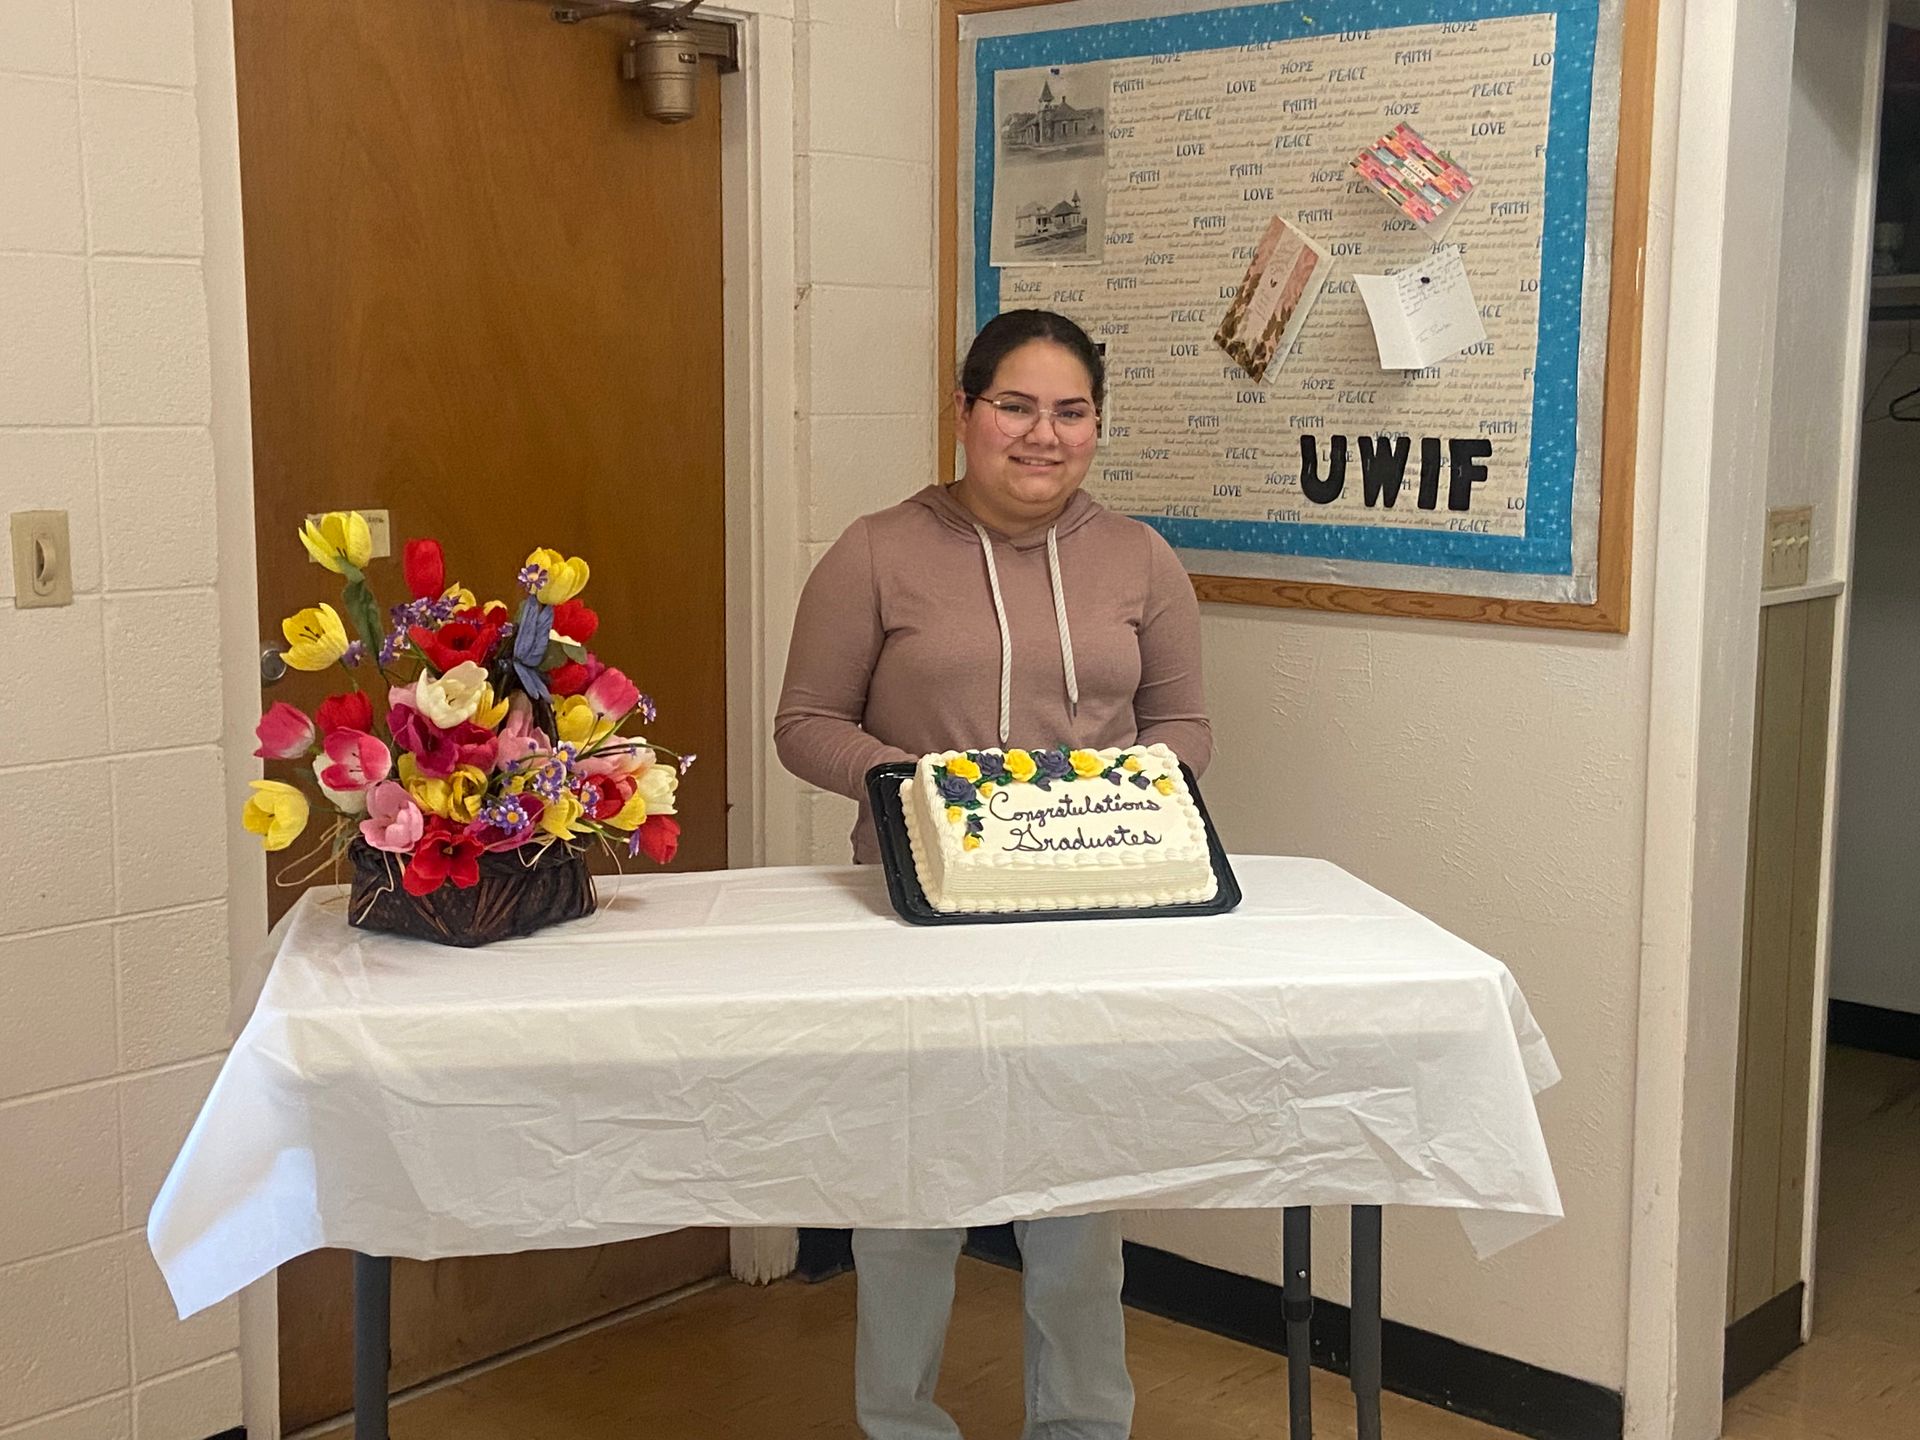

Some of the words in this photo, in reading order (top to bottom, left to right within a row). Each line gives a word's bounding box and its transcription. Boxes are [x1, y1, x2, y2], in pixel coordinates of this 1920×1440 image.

[1339, 30, 1372, 43] LOVE
[1395, 50, 1432, 66] FAITH
[1533, 53, 1553, 67] LO
[1280, 60, 1314, 75] HOPE
[1328, 66, 1368, 83] PEACE
[1112, 79, 1144, 93] FAITH
[1226, 80, 1256, 94] LOVE
[1471, 81, 1516, 98] PEACE
[1283, 98, 1317, 113] FAITH
[1384, 101, 1421, 117] HOPE
[1177, 106, 1213, 122] PEACE
[1471, 121, 1506, 137] LOVE
[1275, 133, 1313, 149] PEACE
[1176, 143, 1205, 157] LOVE
[1129, 170, 1160, 184] FAITH
[1230, 163, 1263, 178] FAITH
[1311, 168, 1345, 183] HOPE
[1243, 188, 1274, 201] LOVE
[1298, 208, 1333, 224] FAITH
[1490, 201, 1530, 217] FAITH
[1193, 216, 1226, 230] FAITH
[1105, 231, 1134, 245] HOPE
[1330, 243, 1362, 256] LOVE
[1144, 251, 1175, 265] HOPE
[1014, 279, 1042, 292] HOPE
[1107, 277, 1137, 291] FAITH
[1520, 279, 1539, 292] LO
[1053, 290, 1086, 302] PEACE
[1170, 309, 1207, 322] PEACE
[1100, 322, 1129, 334] HOPE
[1170, 344, 1199, 357] LOVE
[1124, 367, 1155, 380] FAITH
[1302, 377, 1336, 390] HOPE
[1236, 391, 1266, 404] LOVE
[1338, 391, 1377, 404] PEACE
[1188, 415, 1220, 429] FAITH
[1289, 415, 1324, 428] FAITH
[1479, 421, 1518, 435] FAITH
[1109, 427, 1131, 437] OPE
[1140, 447, 1170, 460] HOPE
[1224, 447, 1259, 460] PEACE
[1103, 469, 1133, 482] FAITH
[1264, 471, 1298, 486] HOPE
[1300, 435, 1493, 511] UWIF
[1213, 485, 1242, 497] LOVE
[1507, 497, 1525, 510] LO
[1166, 505, 1200, 518] PEACE
[1267, 509, 1300, 521] FAITH
[1450, 518, 1491, 533] PEACE
[989, 791, 1162, 827] Congratulations
[1002, 823, 1162, 851] Graduates
